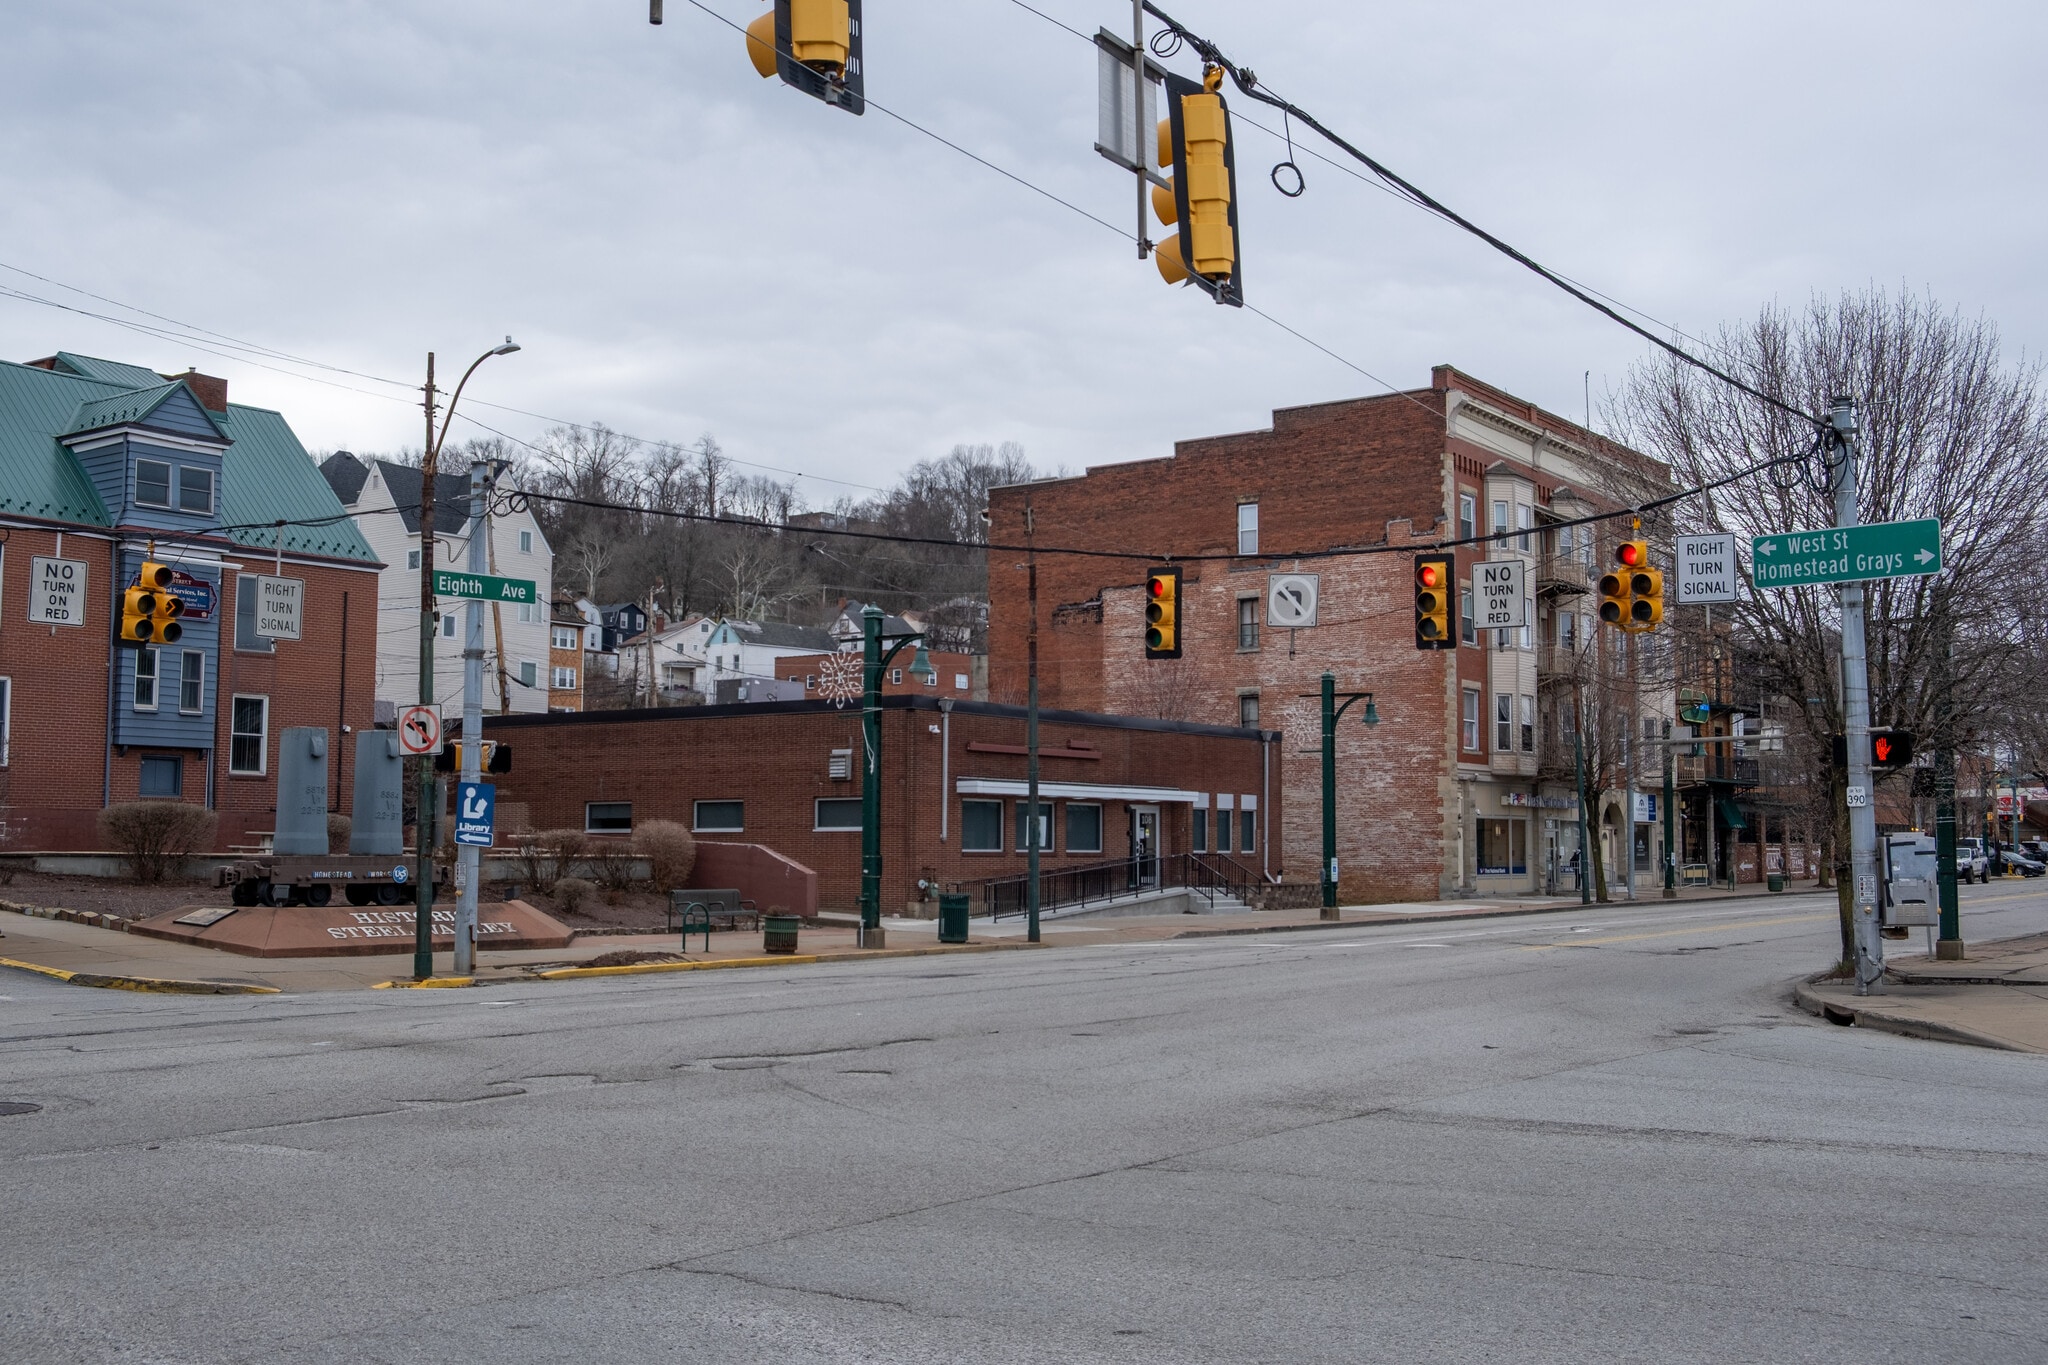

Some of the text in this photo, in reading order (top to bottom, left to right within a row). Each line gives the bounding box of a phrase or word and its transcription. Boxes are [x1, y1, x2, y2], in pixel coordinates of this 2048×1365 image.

[1687, 542, 1725, 555] RIGHT
[1788, 532, 1849, 554] West St
[46, 563, 73, 579] NO
[1689, 562, 1722, 575] TURN
[1757, 553, 1903, 580] Homestead Grays
[1485, 567, 1511, 582] NO
[43, 580, 75, 593] TURN
[265, 583, 296, 597] RIGHT
[439, 576, 526, 599] Eighth Ave
[1483, 585, 1514, 596] TURN
[1684, 581, 1730, 595] SIGNAL
[49, 594, 67, 606] ON
[1490, 599, 1507, 610] ON
[46, 608, 69, 620] RED
[266, 601, 293, 614] TURN
[1488, 612, 1511, 623] RED
[261, 618, 297, 632] SIGNAL
[1848, 795, 1865, 804] 390
[459, 822, 491, 833] Library
[314, 871, 352, 879] HOMESTEAD
[395, 869, 407, 879] USS
[327, 922, 416, 940] STEEL
